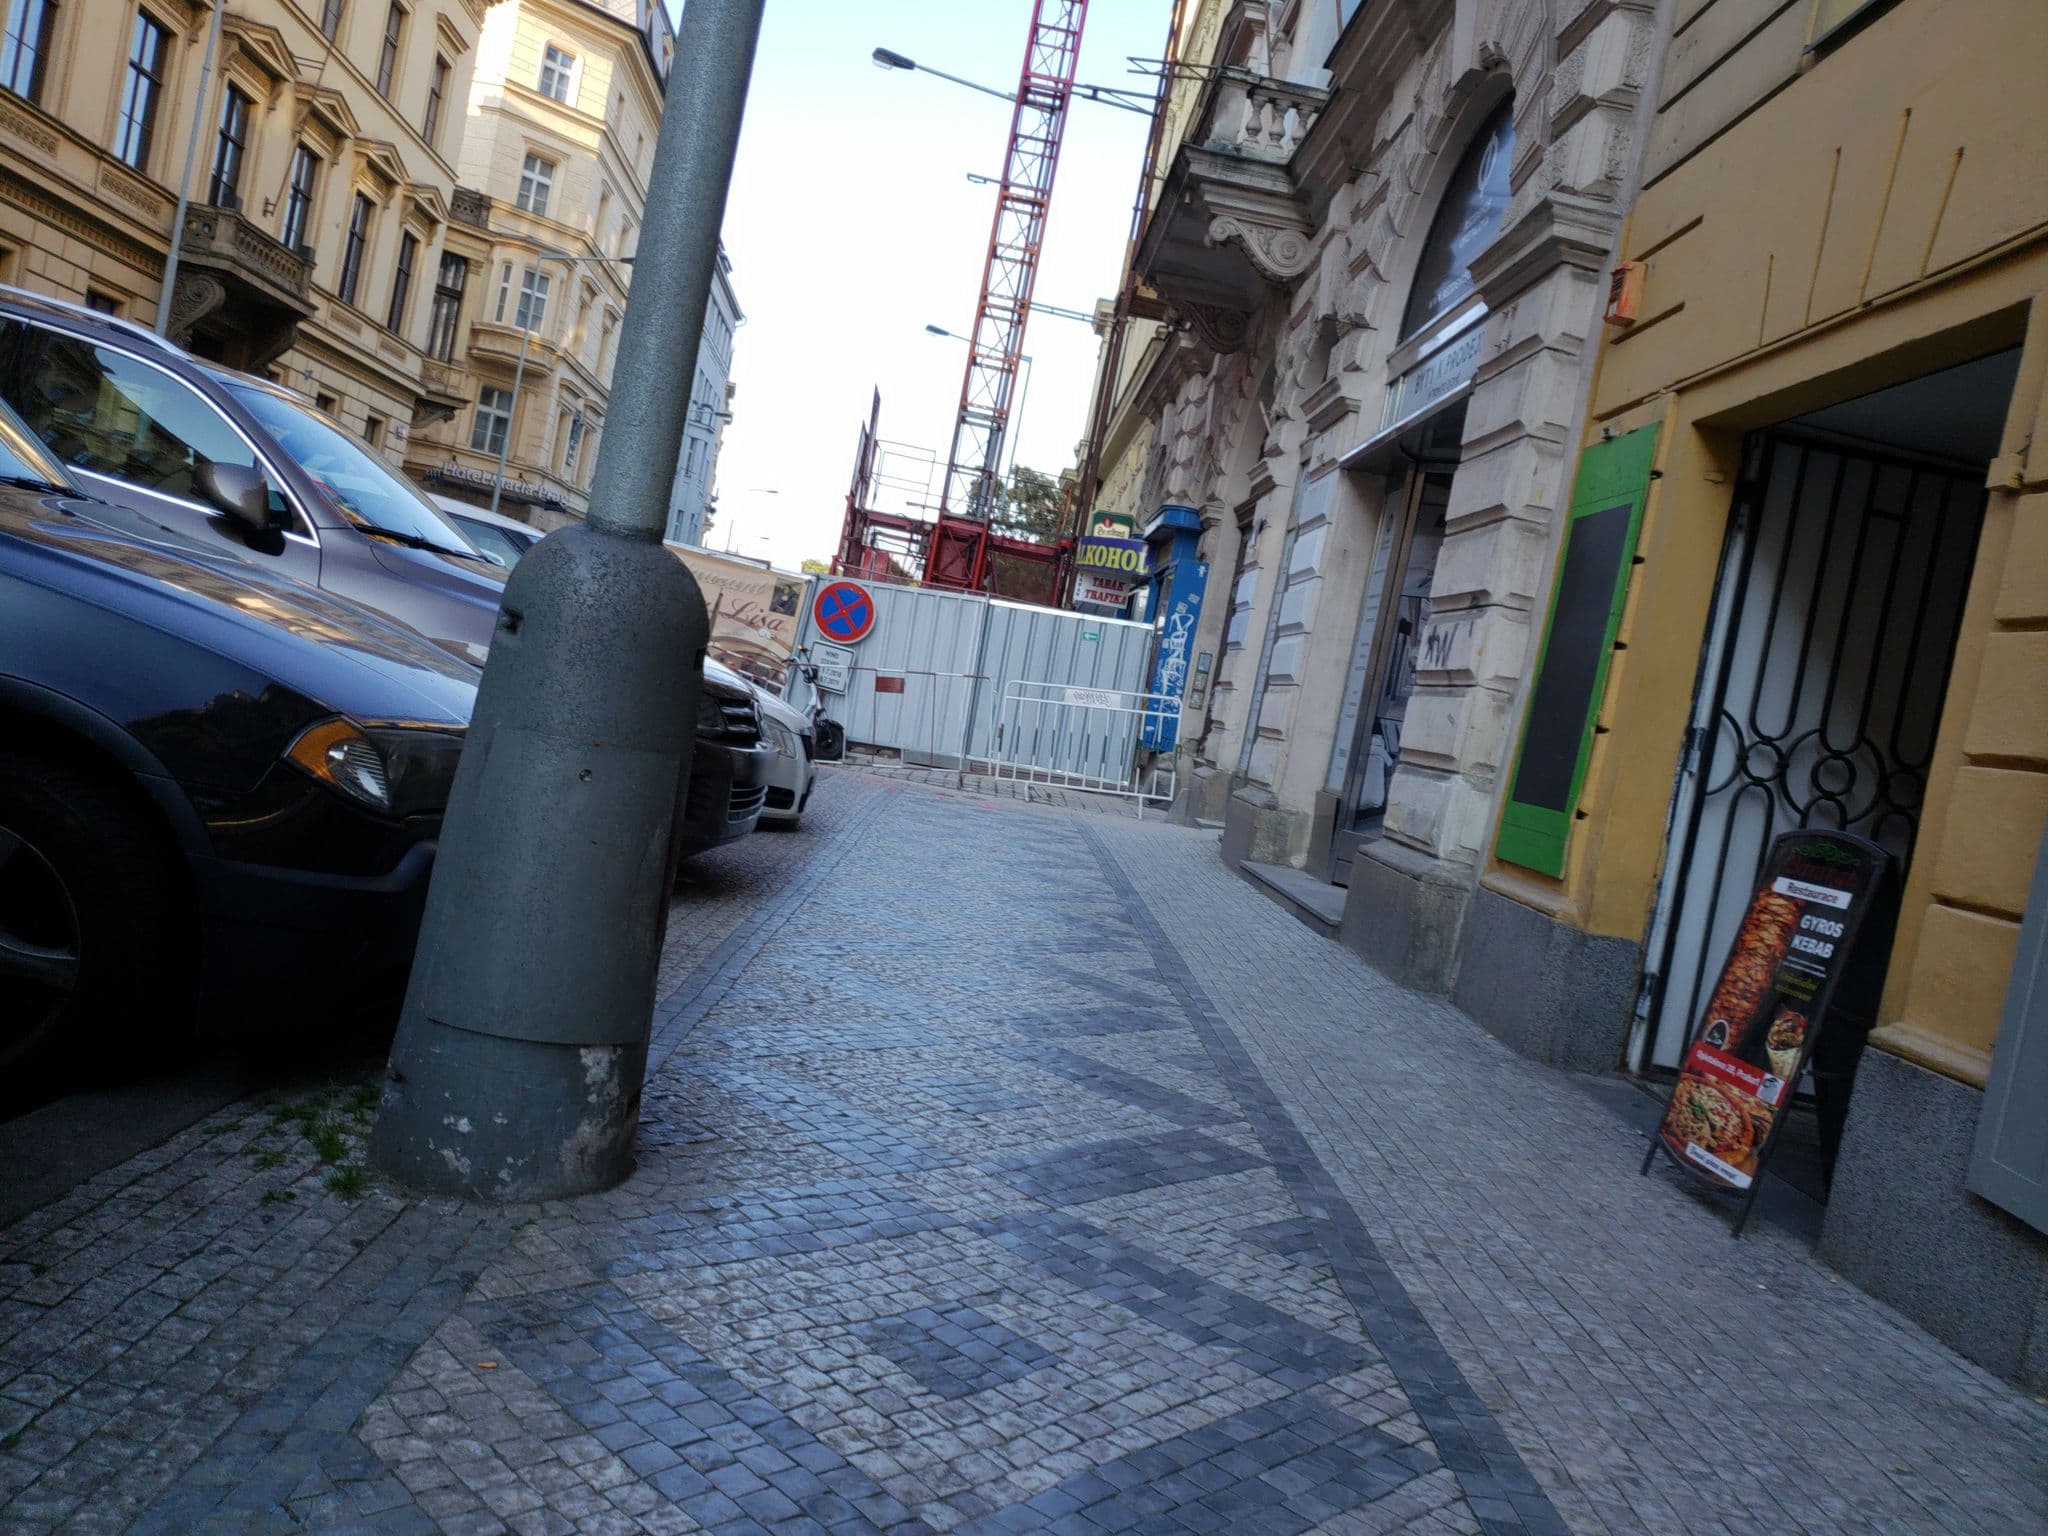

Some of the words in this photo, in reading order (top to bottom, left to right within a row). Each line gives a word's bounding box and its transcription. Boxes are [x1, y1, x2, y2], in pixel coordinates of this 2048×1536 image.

[443, 461, 491, 484] Hotel
[1092, 577, 1125, 592] TABAK
[1085, 590, 1126, 605] TRAFIKA
[718, 598, 784, 631] Lisa
[1800, 914, 1844, 938] GYROS
[1790, 934, 1834, 959] KEBAB
